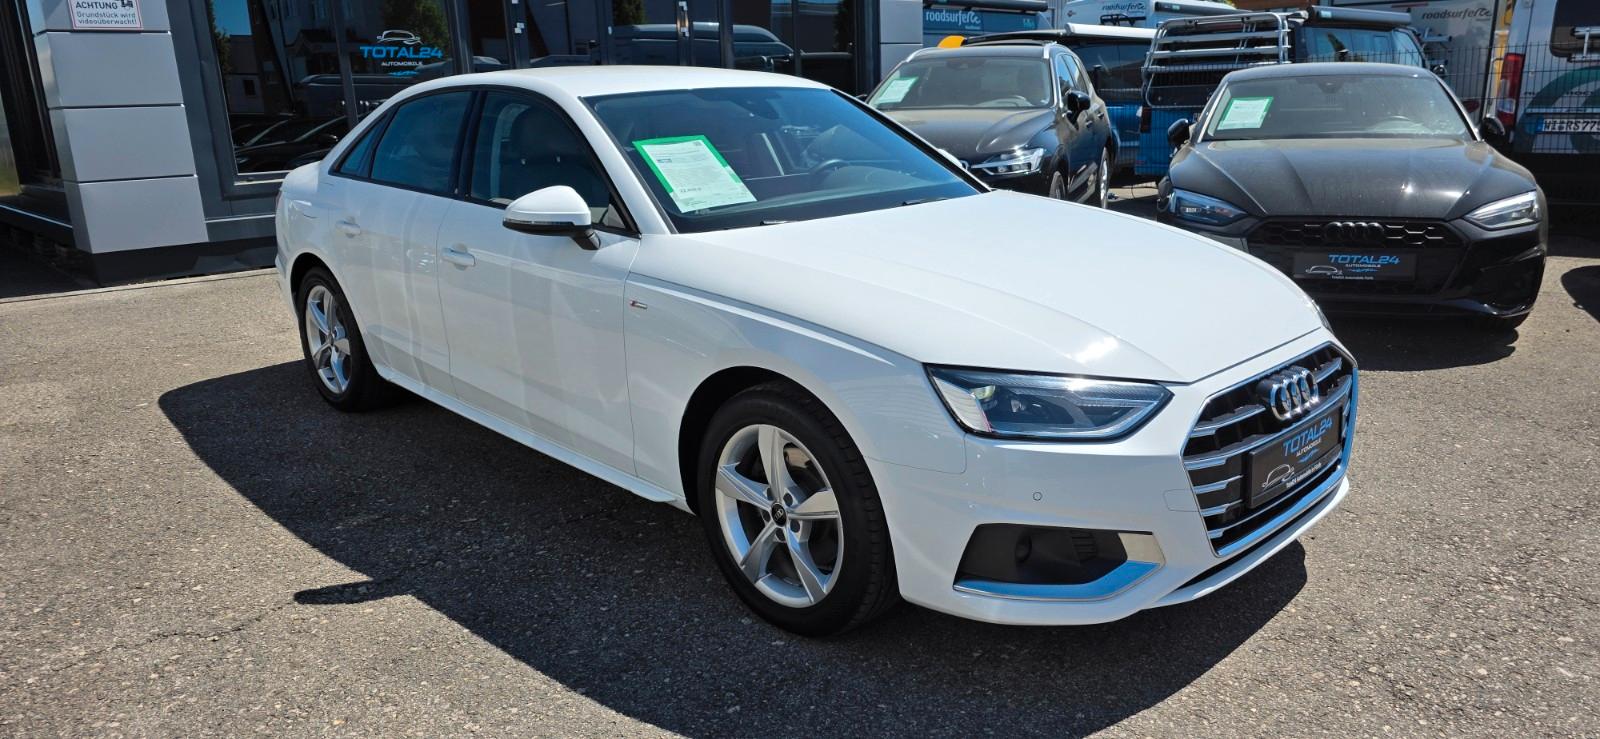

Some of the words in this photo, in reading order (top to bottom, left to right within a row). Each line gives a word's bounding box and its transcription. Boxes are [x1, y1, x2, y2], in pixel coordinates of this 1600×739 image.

[925, 9, 981, 26] roadsurfer
[1422, 7, 1491, 20] roadsurfer
[360, 46, 443, 58] TOTAL24
[1328, 254, 1400, 264] TOTAL24
[1284, 417, 1333, 456] TOTAL24
